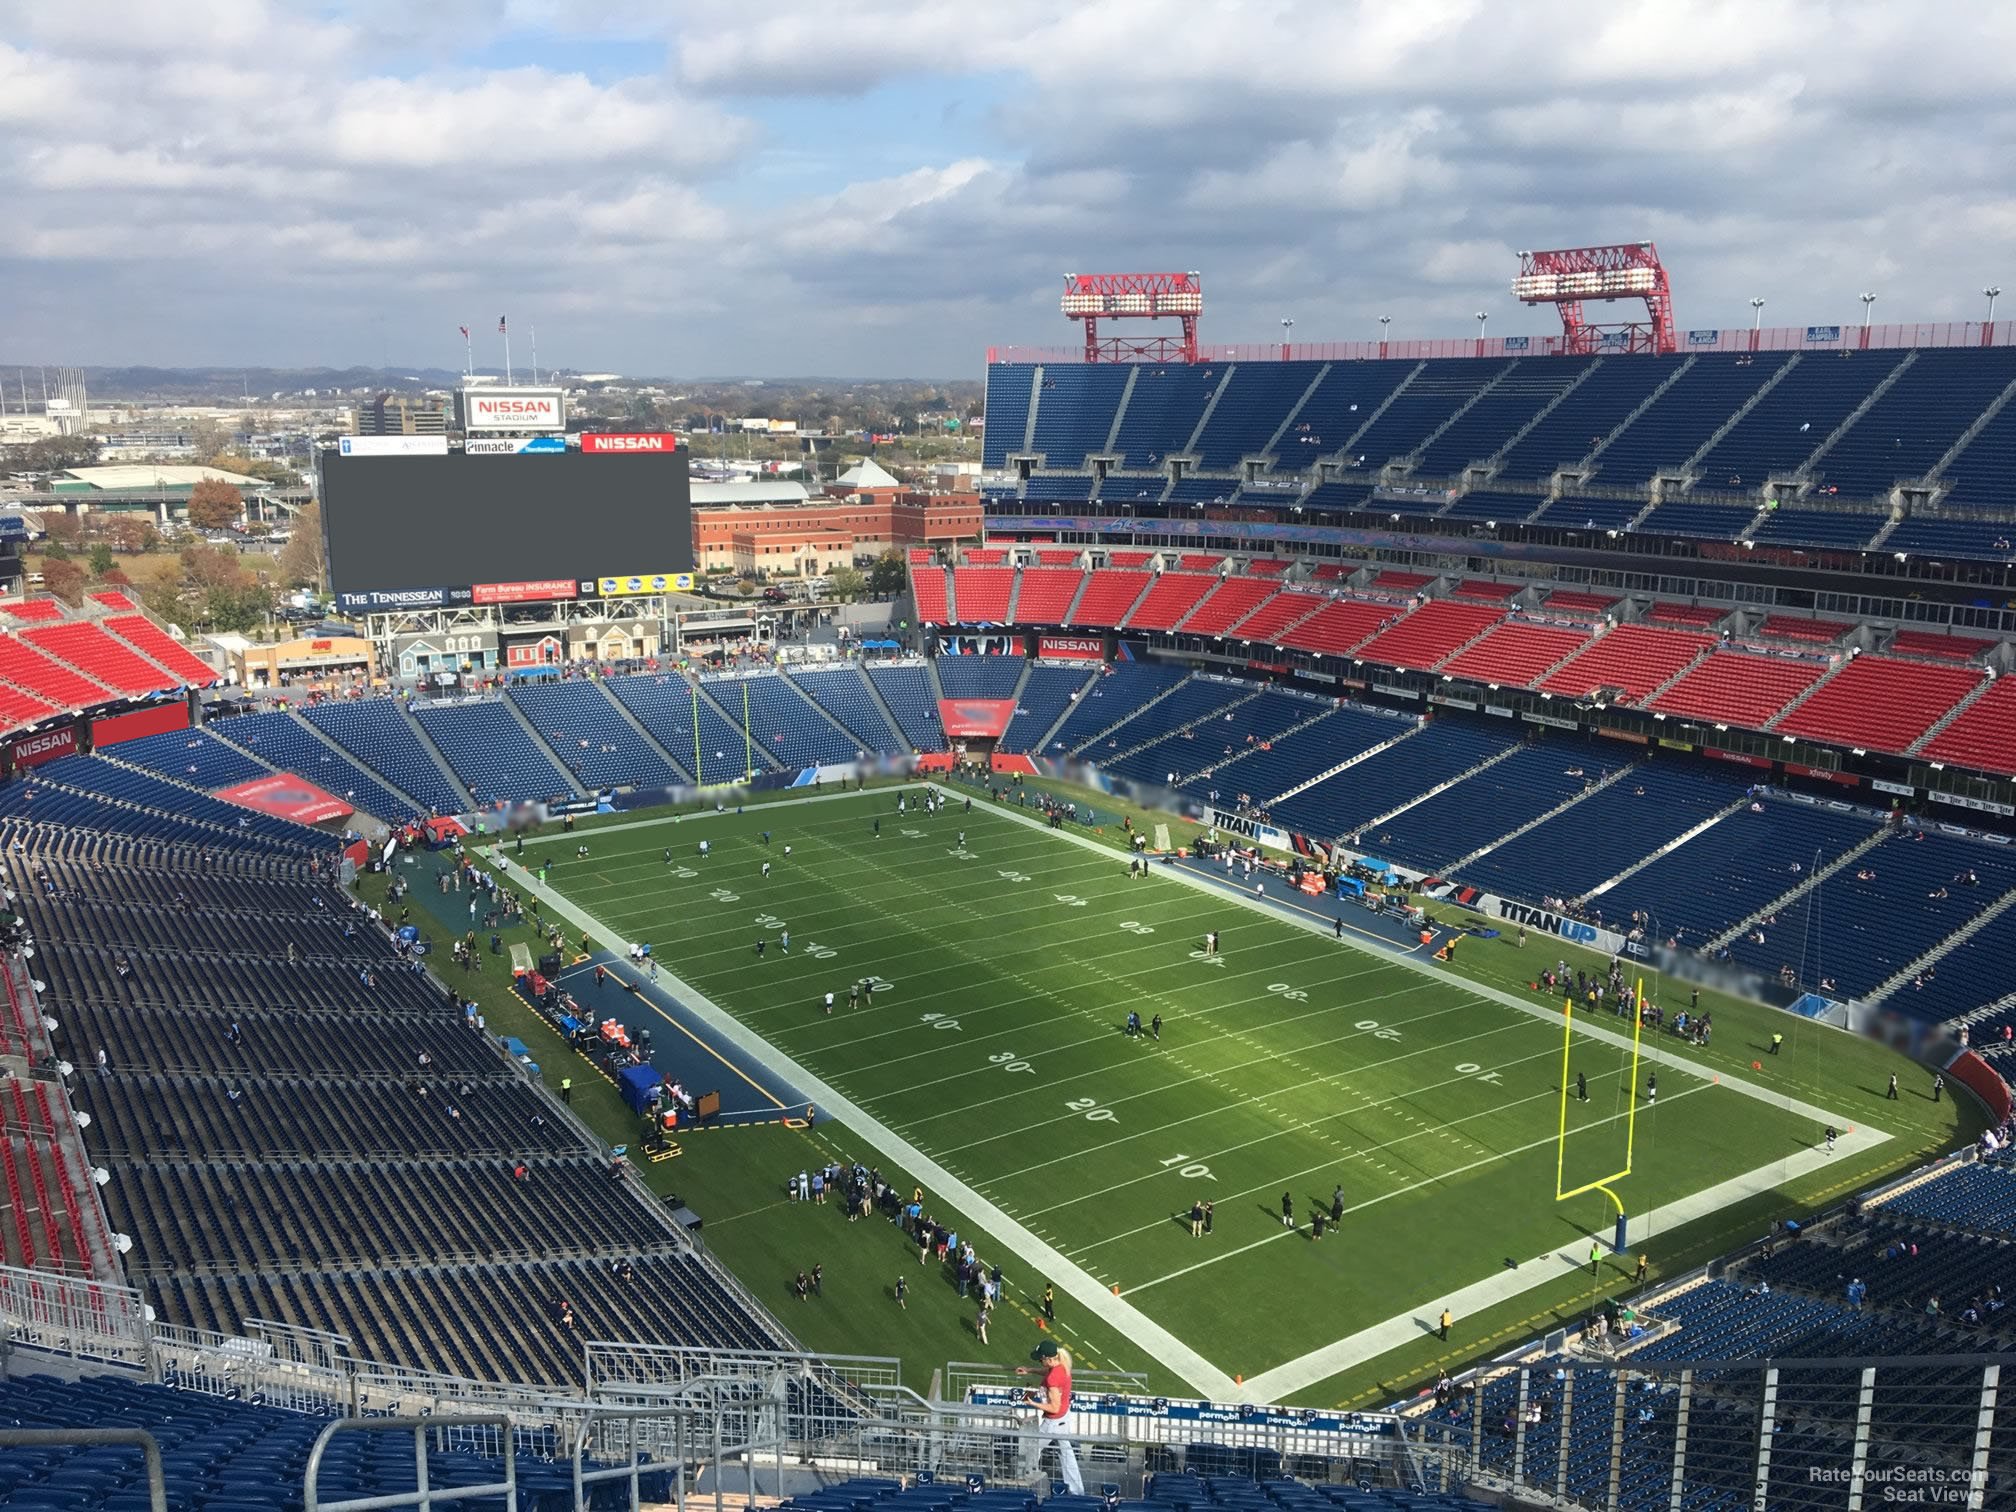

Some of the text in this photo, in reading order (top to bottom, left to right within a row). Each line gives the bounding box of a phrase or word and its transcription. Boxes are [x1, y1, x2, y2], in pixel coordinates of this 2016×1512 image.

[479, 401, 551, 413] NISSAN
[493, 414, 538, 422] STADIUM
[467, 441, 514, 453] Pinnacle
[595, 437, 662, 449] NISSAN
[342, 593, 367, 605] THE
[370, 590, 443, 604] TENNESSEAN
[1043, 640, 1100, 652] NISSAN
[16, 731, 72, 759] NISSAN
[1723, 753, 1752, 763] NISSAN
[1808, 768, 1834, 780] xfinity
[920, 1013, 960, 1030] 40
[988, 1052, 1031, 1073] 30
[1064, 1097, 1114, 1121] 20
[1159, 1153, 1210, 1178] 10
[987, 1398, 1027, 1407] permob
[1199, 1412, 1240, 1422] permobil
[1339, 1422, 1381, 1433] permobil
